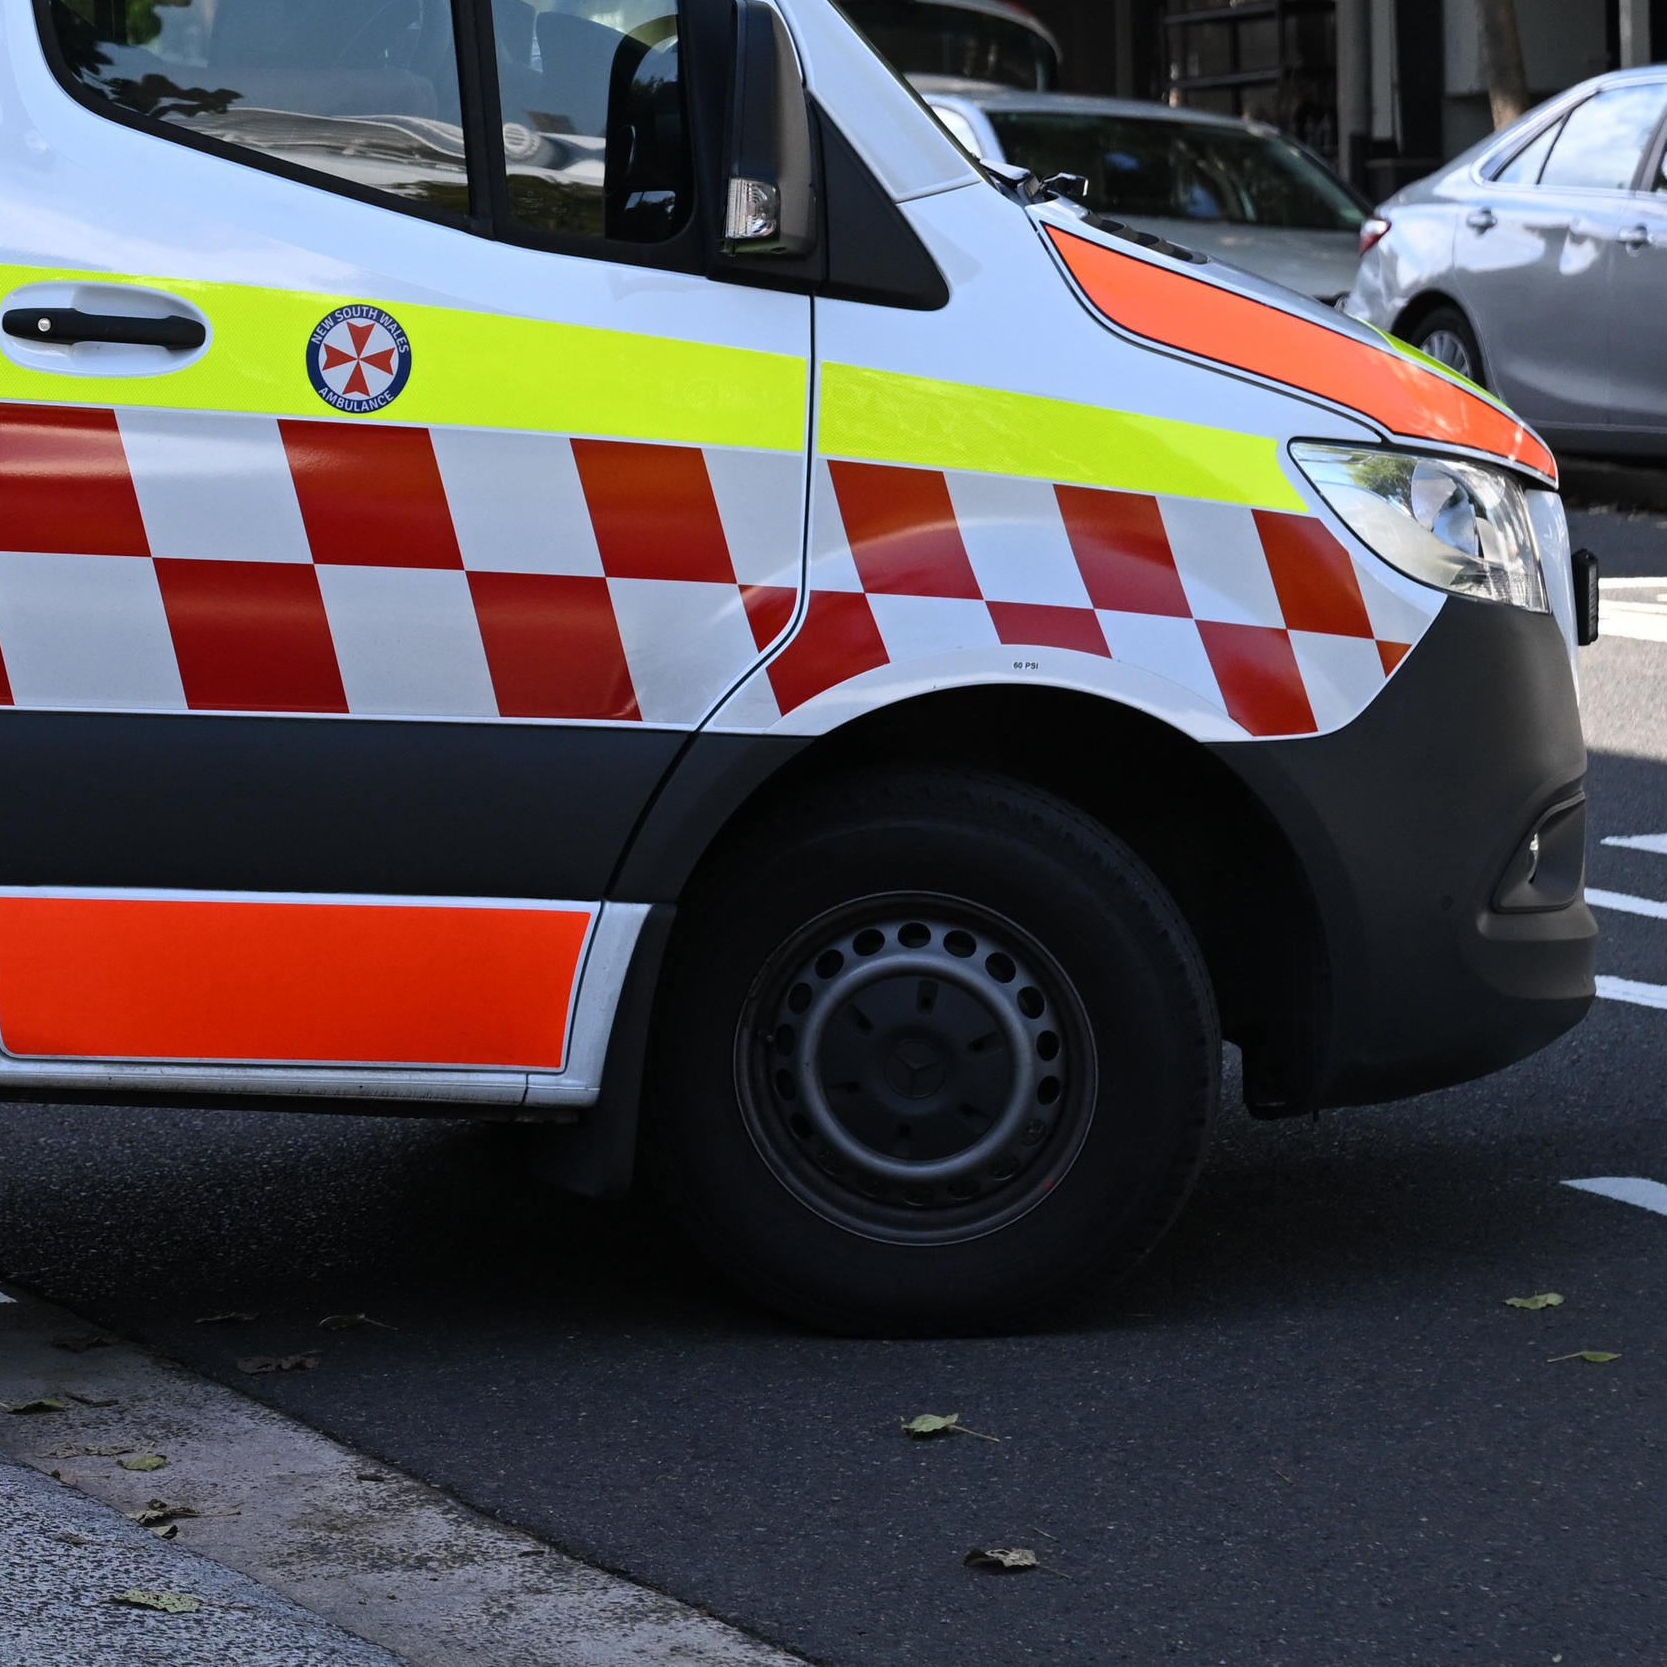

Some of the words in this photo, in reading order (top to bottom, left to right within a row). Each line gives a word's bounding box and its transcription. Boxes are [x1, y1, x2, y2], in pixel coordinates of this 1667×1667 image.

[310, 315, 335, 345] NEW
[335, 306, 378, 322] SOUTH
[379, 312, 410, 354] WALES
[318, 386, 394, 412] AMBULANCE
[1013, 661, 1023, 669] 60
[1025, 662, 1039, 670] PSI
